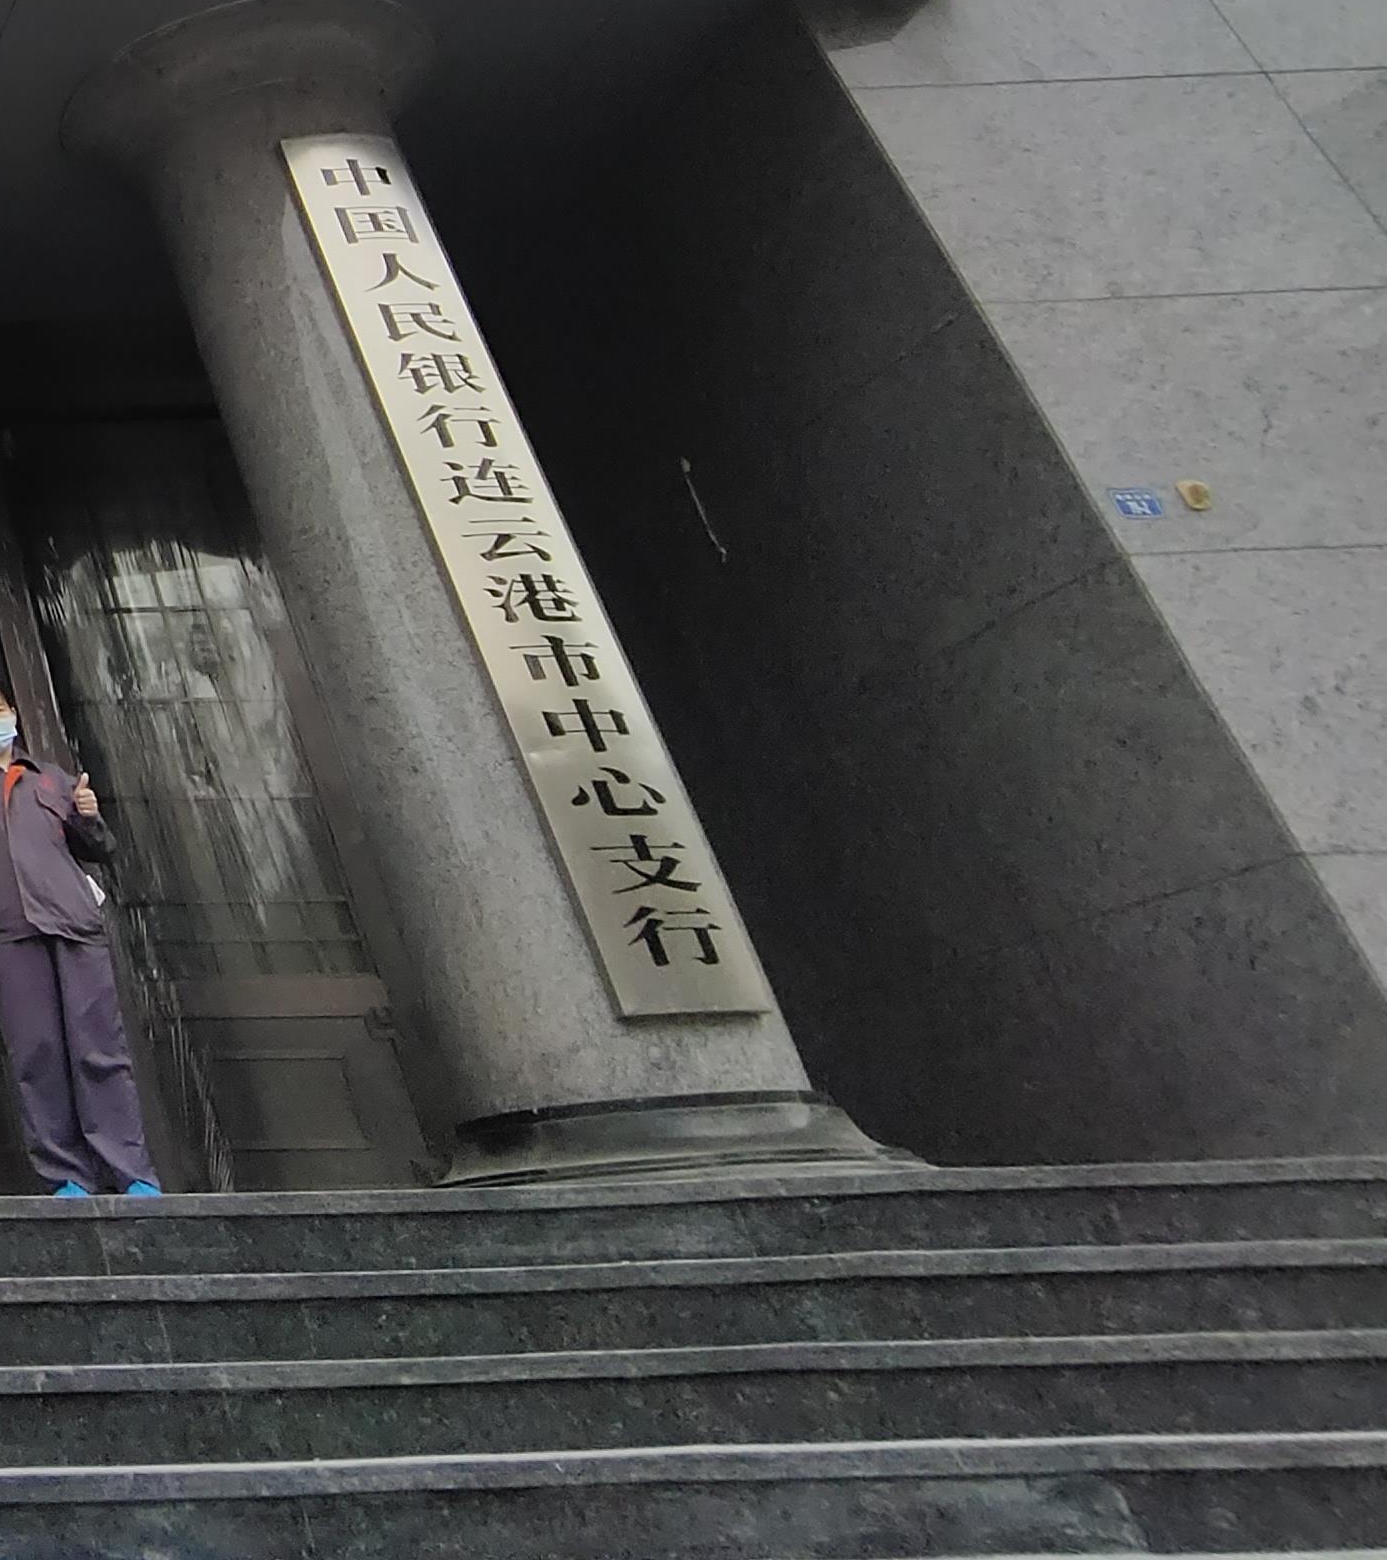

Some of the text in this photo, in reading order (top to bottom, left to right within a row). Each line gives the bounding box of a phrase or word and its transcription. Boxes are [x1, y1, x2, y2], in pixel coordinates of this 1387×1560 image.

[321, 157, 723, 968] 中国人民银行连云港市中心支行
